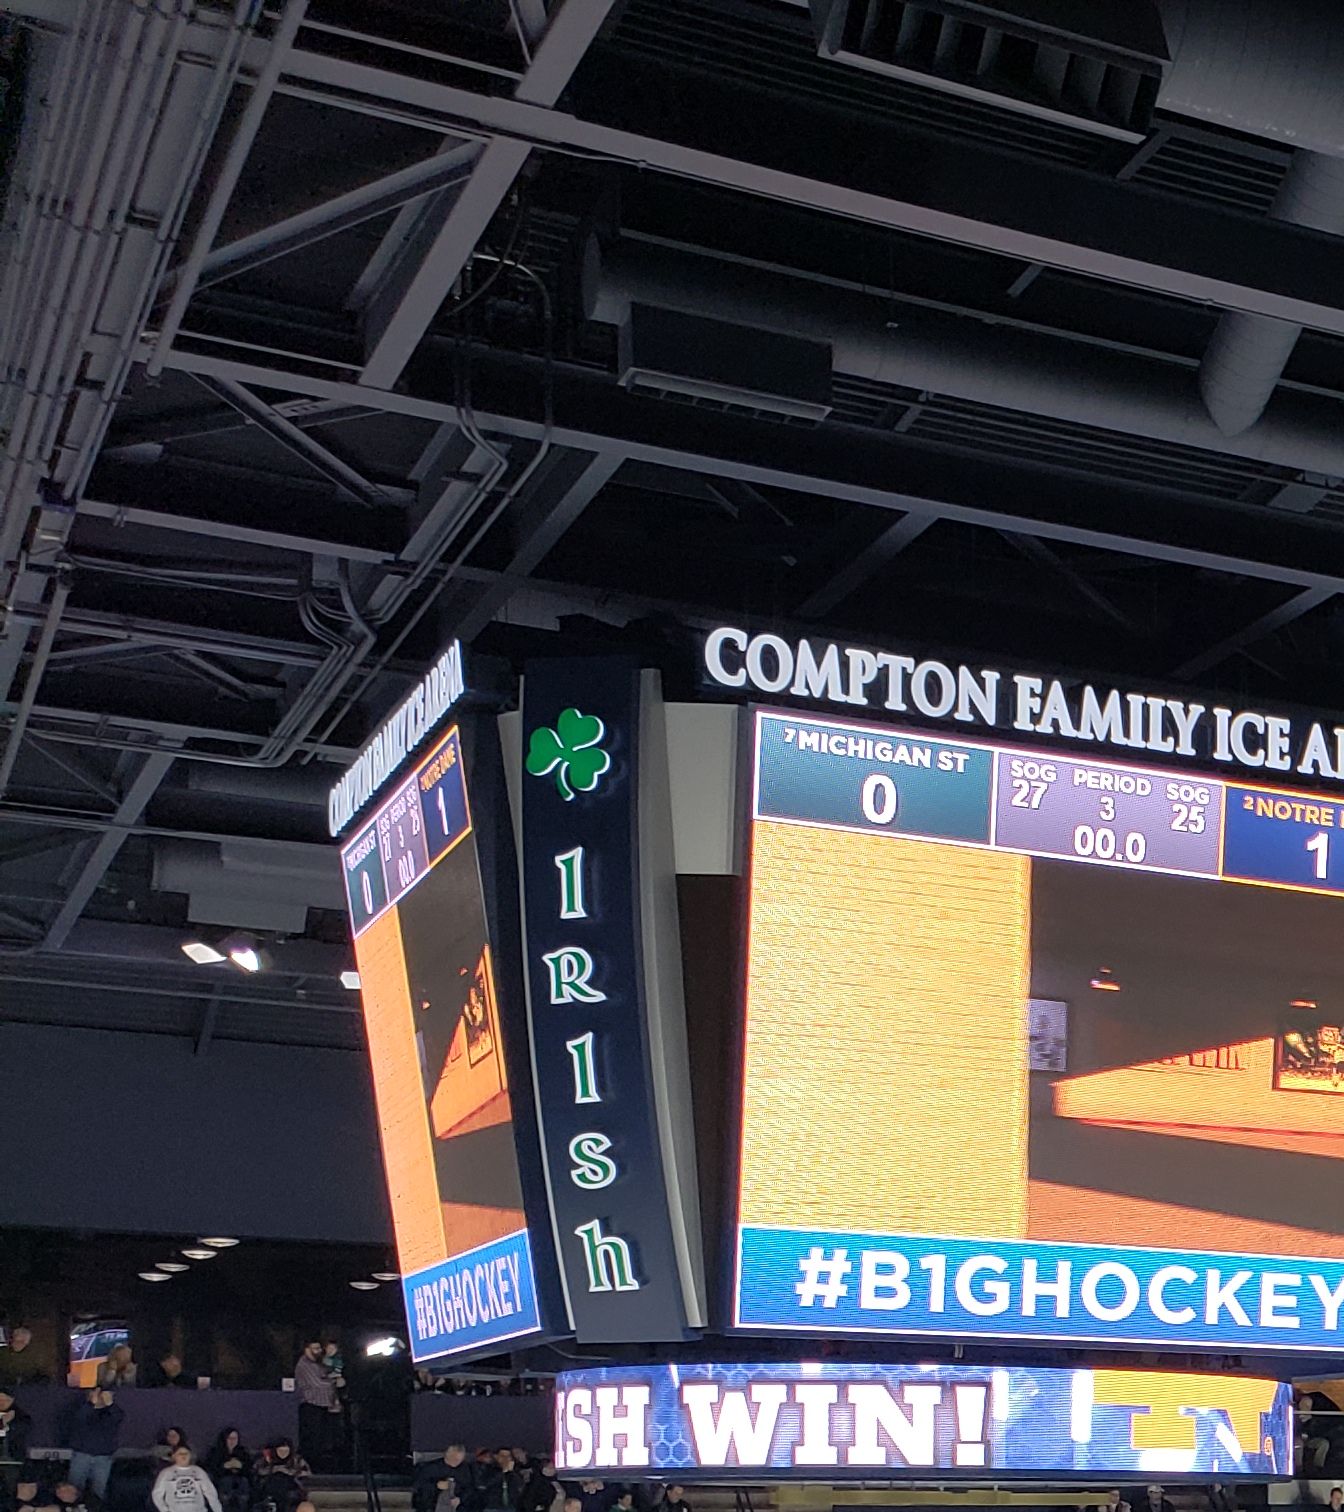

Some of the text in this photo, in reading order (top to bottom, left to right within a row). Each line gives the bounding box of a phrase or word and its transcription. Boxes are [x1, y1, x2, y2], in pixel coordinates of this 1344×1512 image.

[705, 627, 999, 726] COMPTON
[1013, 674, 1205, 756] FAMILY
[1213, 707, 1292, 772] ICE
[798, 730, 931, 769] MICHIGAN
[937, 751, 969, 773] ST
[861, 773, 897, 824] 0
[1011, 760, 1210, 806] SOG PERIOD SOG
[1011, 779, 1206, 834] 27 3 25
[438, 786, 450, 835] 1
[1256, 797, 1334, 828] NOTRE
[1074, 825, 1146, 864] 00.0
[1306, 832, 1329, 880] 1
[362, 870, 373, 915] 0
[681, 1383, 990, 1467] WIN!
